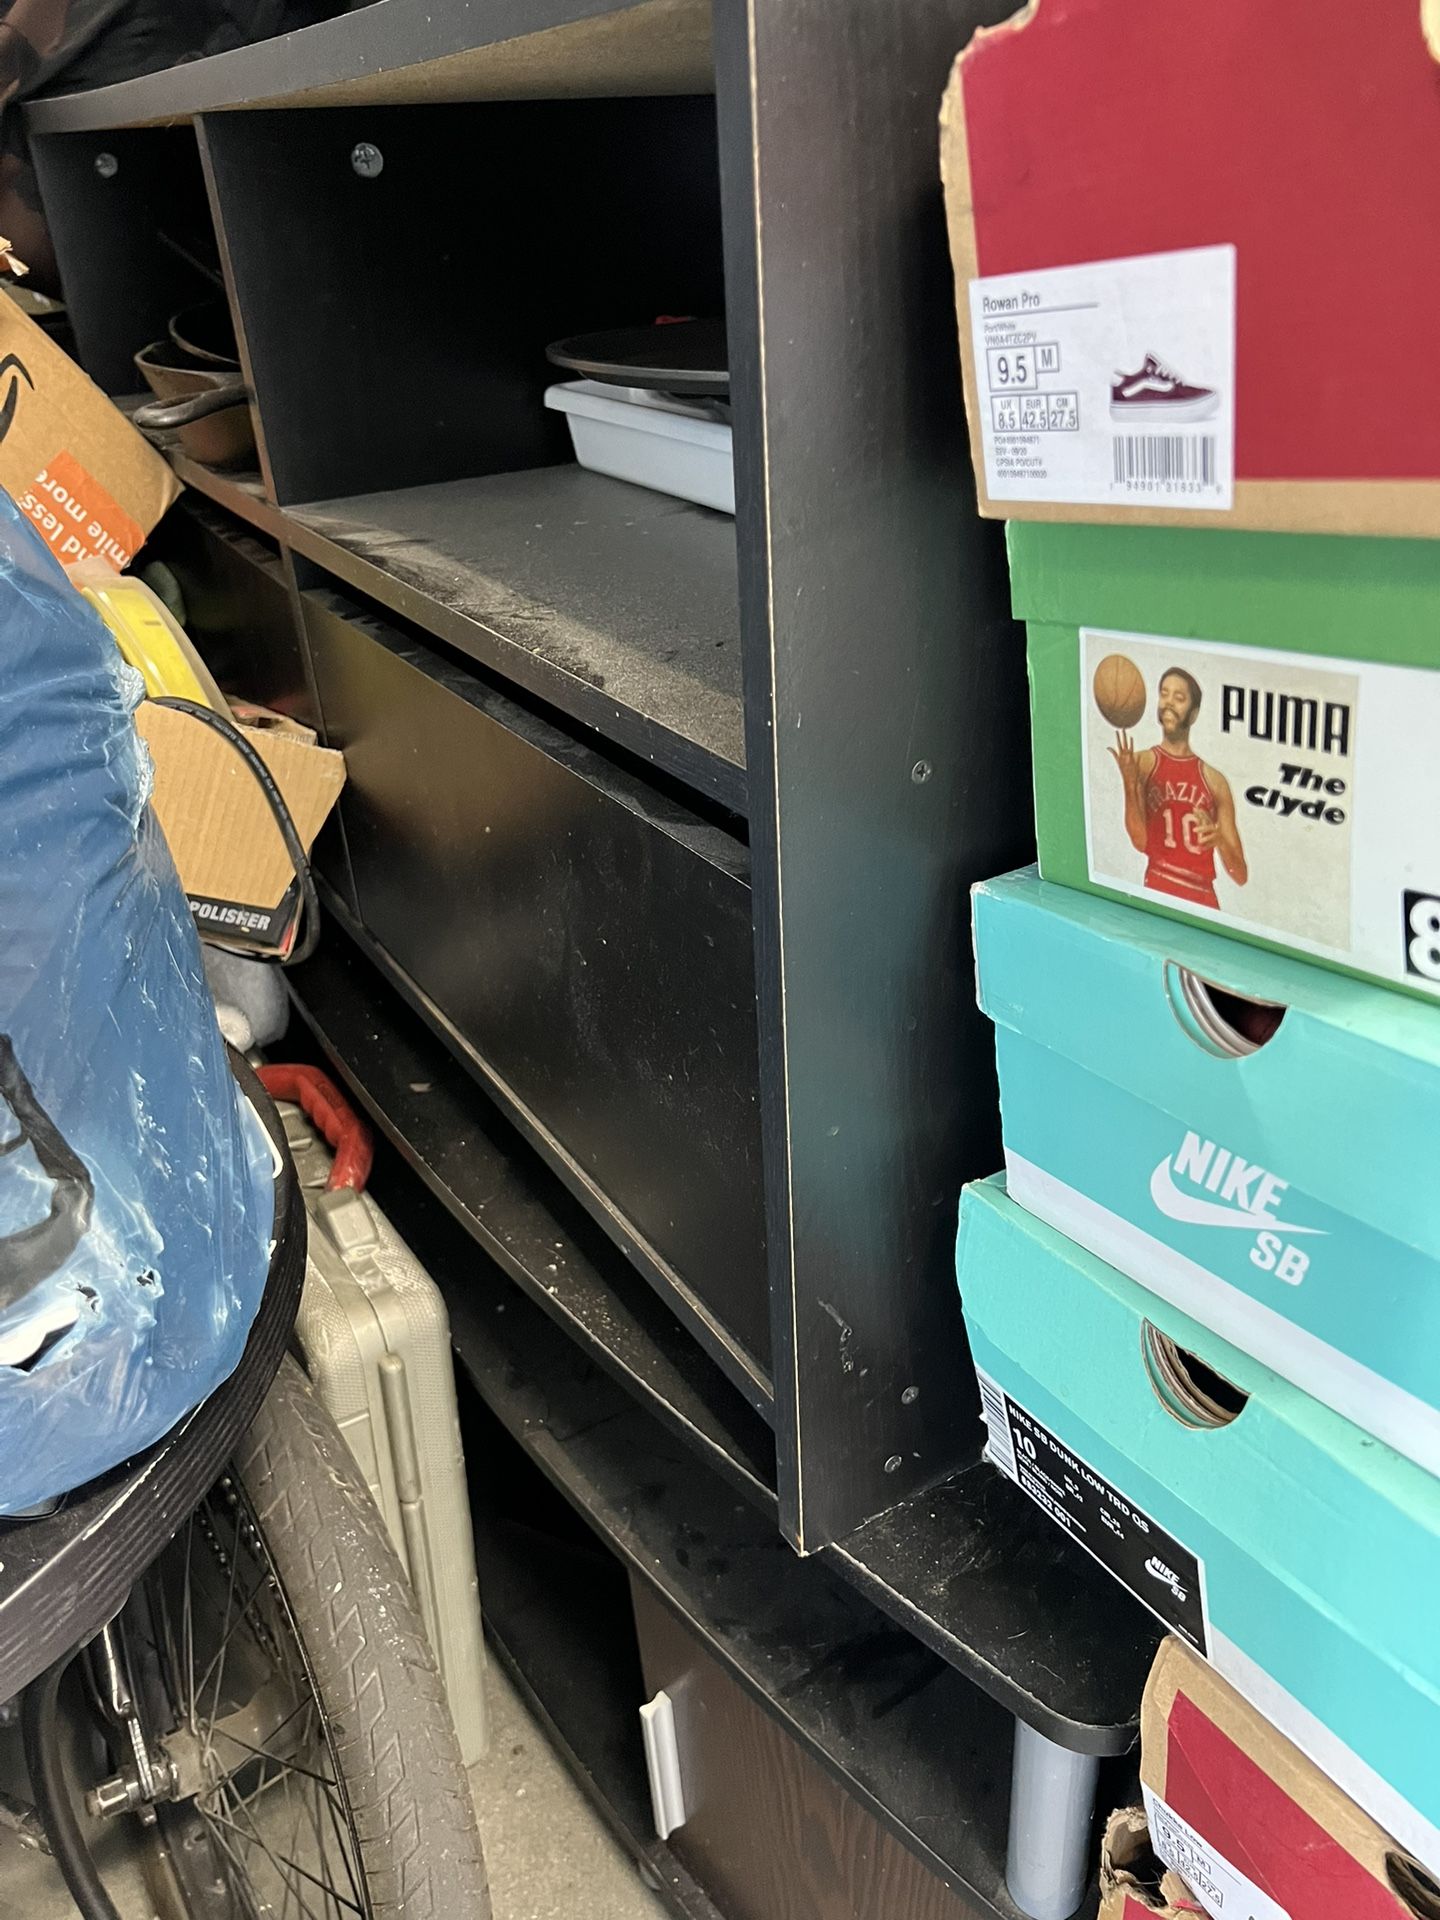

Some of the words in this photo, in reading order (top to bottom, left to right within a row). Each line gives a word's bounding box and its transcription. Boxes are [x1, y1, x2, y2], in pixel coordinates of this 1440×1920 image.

[983, 296, 1018, 312] Rowan
[1021, 293, 1041, 308] Pro
[997, 355, 1027, 384] 9.5
[1041, 348, 1053, 367] M
[1026, 399, 1041, 410] EUR
[1056, 398, 1068, 408] CM
[998, 411, 1016, 430] 8.5
[1022, 410, 1047, 430] 42.5
[1051, 409, 1076, 429] 27.5
[35, 469, 88, 523] more
[1221, 684, 1351, 757] PUMA
[1279, 763, 1346, 796] The
[1163, 809, 1202, 855] 10
[189, 900, 272, 932] POLISHER
[1173, 1130, 1291, 1221] NIKE
[1249, 1231, 1311, 1287] SB
[1012, 1427, 1037, 1460] 10
[1008, 1404, 1032, 1432] NIKE
[1033, 1426, 1048, 1445] SB
[1049, 1440, 1080, 1474] DUNK
[1081, 1468, 1105, 1495] LOW
[1106, 1490, 1130, 1516] TRD
[1132, 1514, 1150, 1533] QS
[1151, 1556, 1180, 1584] NIKE
[1171, 1585, 1187, 1602] SB
[1162, 1826, 1185, 1853] 9.5
[1185, 1829, 1203, 1848] Low
[1202, 1880, 1220, 1903] 27.5
